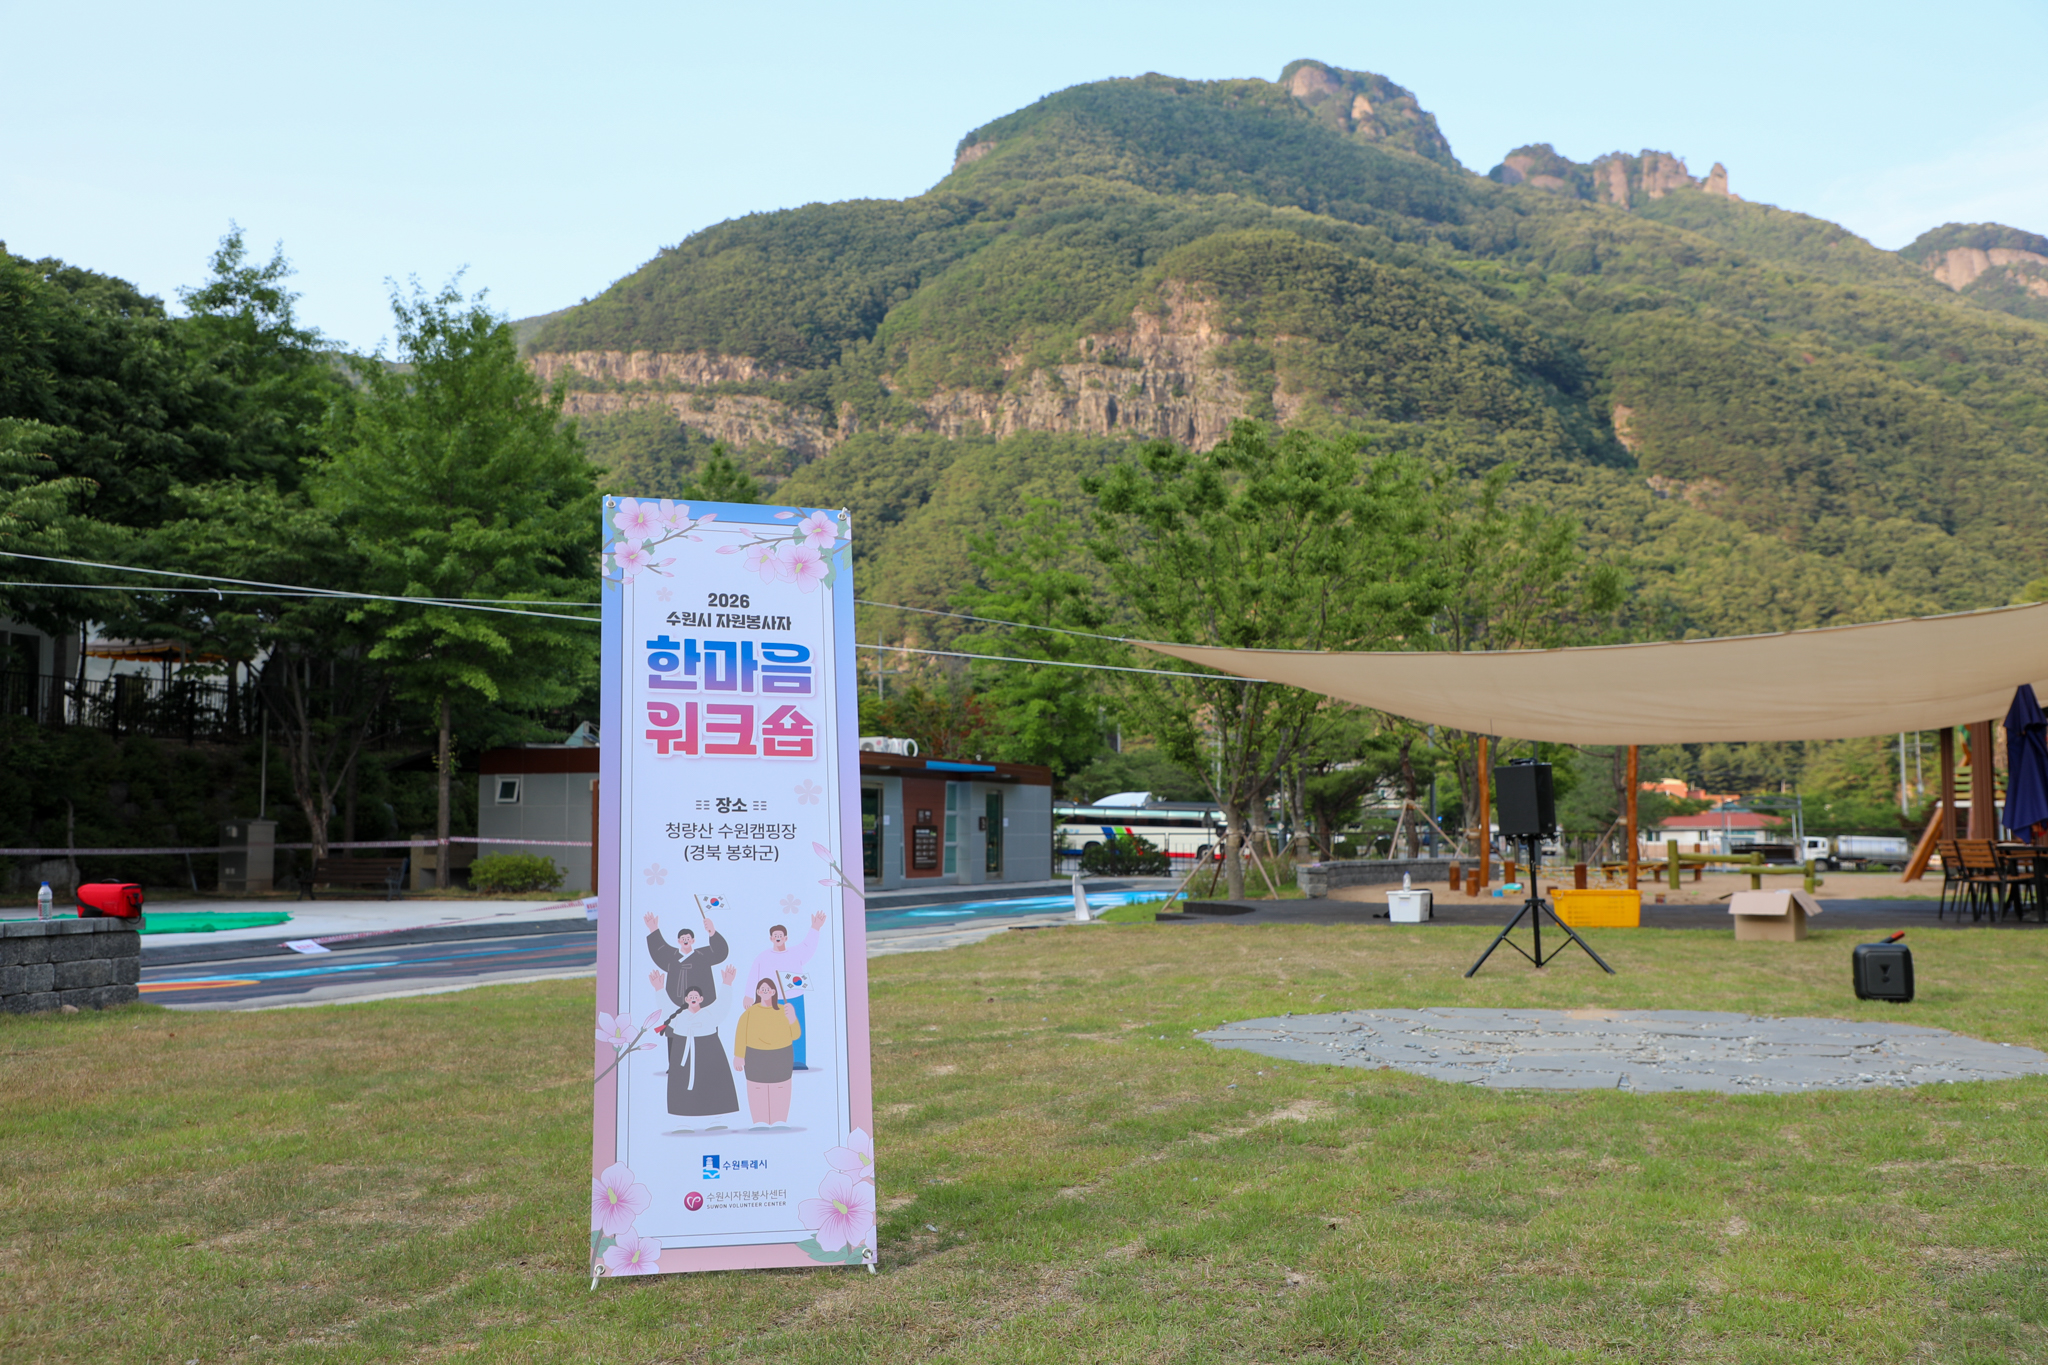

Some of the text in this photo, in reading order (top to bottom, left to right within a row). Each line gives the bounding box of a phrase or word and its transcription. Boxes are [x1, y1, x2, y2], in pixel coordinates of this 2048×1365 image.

[708, 593, 751, 609] 2026
[666, 611, 792, 631] 수원시 자원봉사자
[646, 635, 812, 694] 한마음
[646, 702, 813, 757] 워크숍
[715, 796, 748, 814] 장소
[665, 821, 797, 841] 청량산 수원캠핑장
[683, 844, 780, 863] (경북 봉화군)
[723, 1159, 768, 1170] 수원특례시
[707, 1189, 787, 1202] 수원시자원봉사센터
